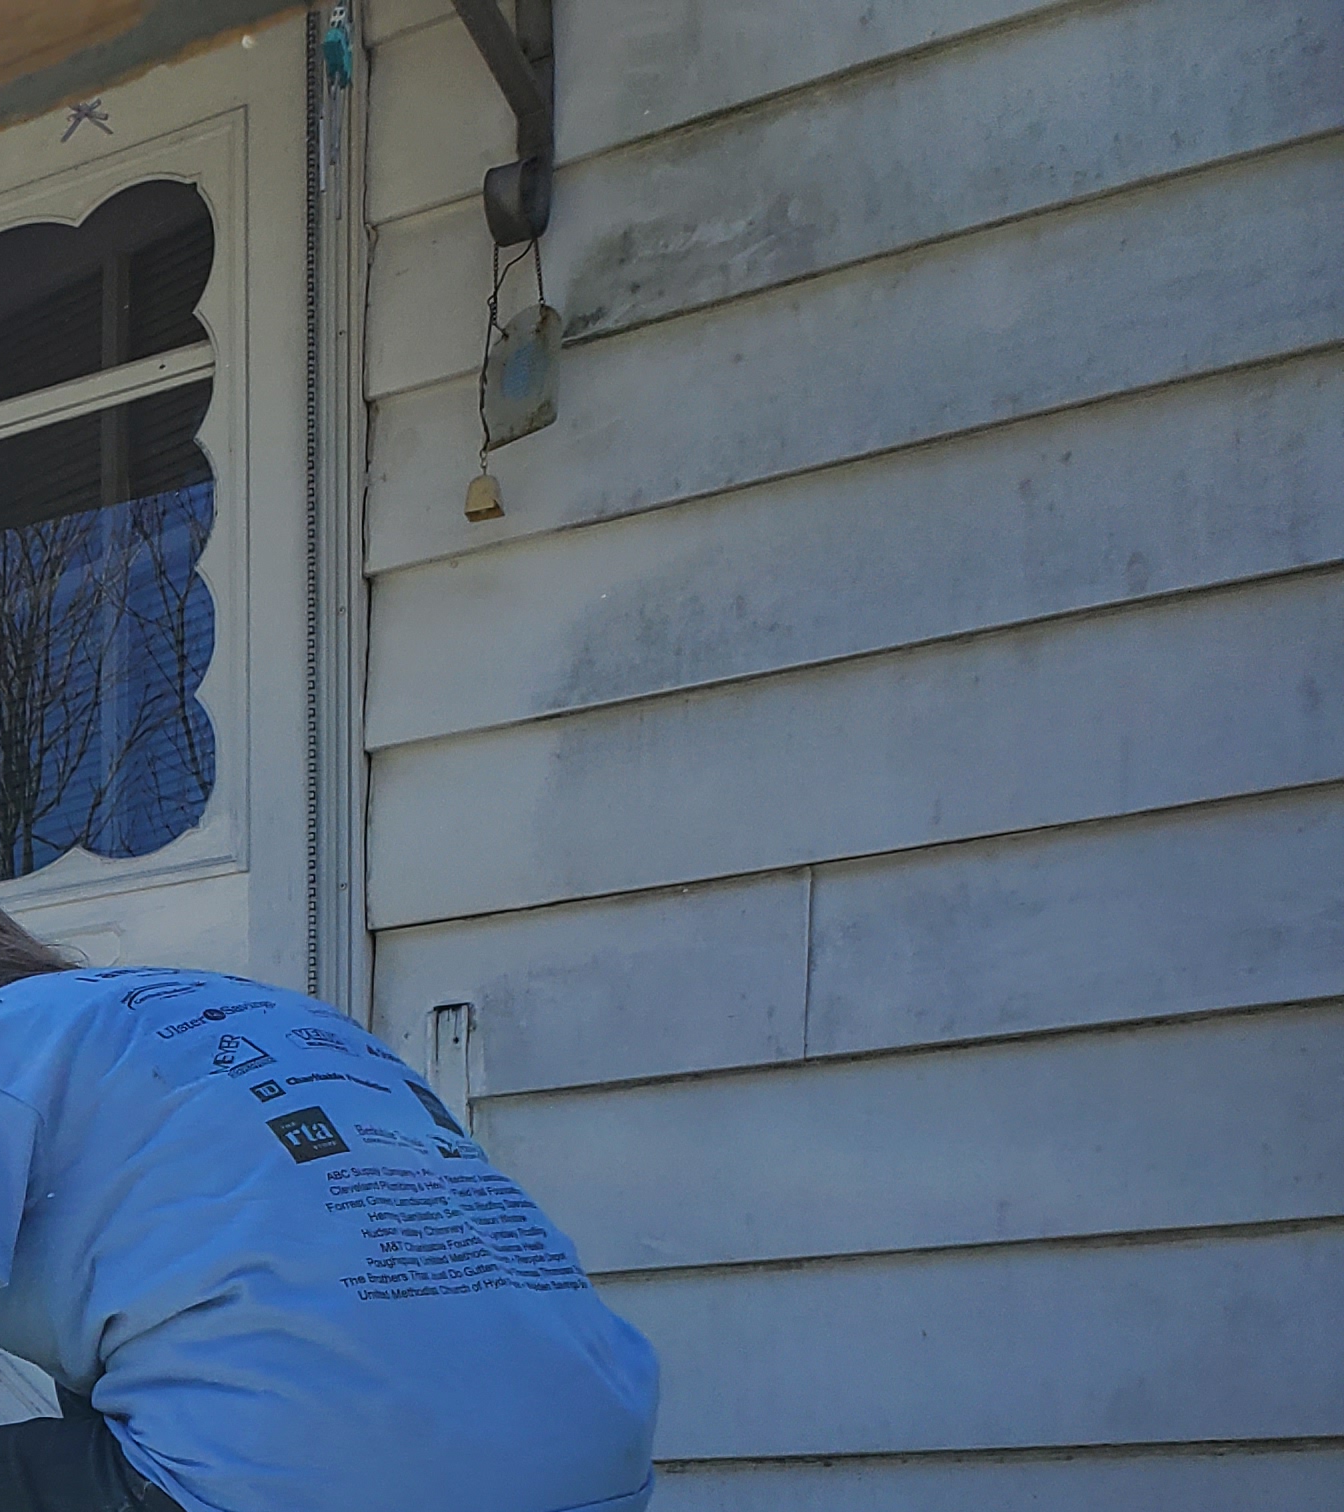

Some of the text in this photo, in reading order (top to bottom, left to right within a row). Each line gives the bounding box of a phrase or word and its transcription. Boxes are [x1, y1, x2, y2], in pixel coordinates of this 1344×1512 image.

[156, 1014, 206, 1040] Ulster
[284, 1121, 334, 1147] rta
[327, 1169, 350, 1181] ABC
[329, 1181, 380, 1196] Cleveland
[448, 1249, 490, 1263] Method
[339, 1275, 366, 1288] The
[366, 1272, 409, 1284] Brothers
[448, 1268, 462, 1279] Do
[463, 1263, 498, 1277] Gutter
[471, 1281, 482, 1293] of
